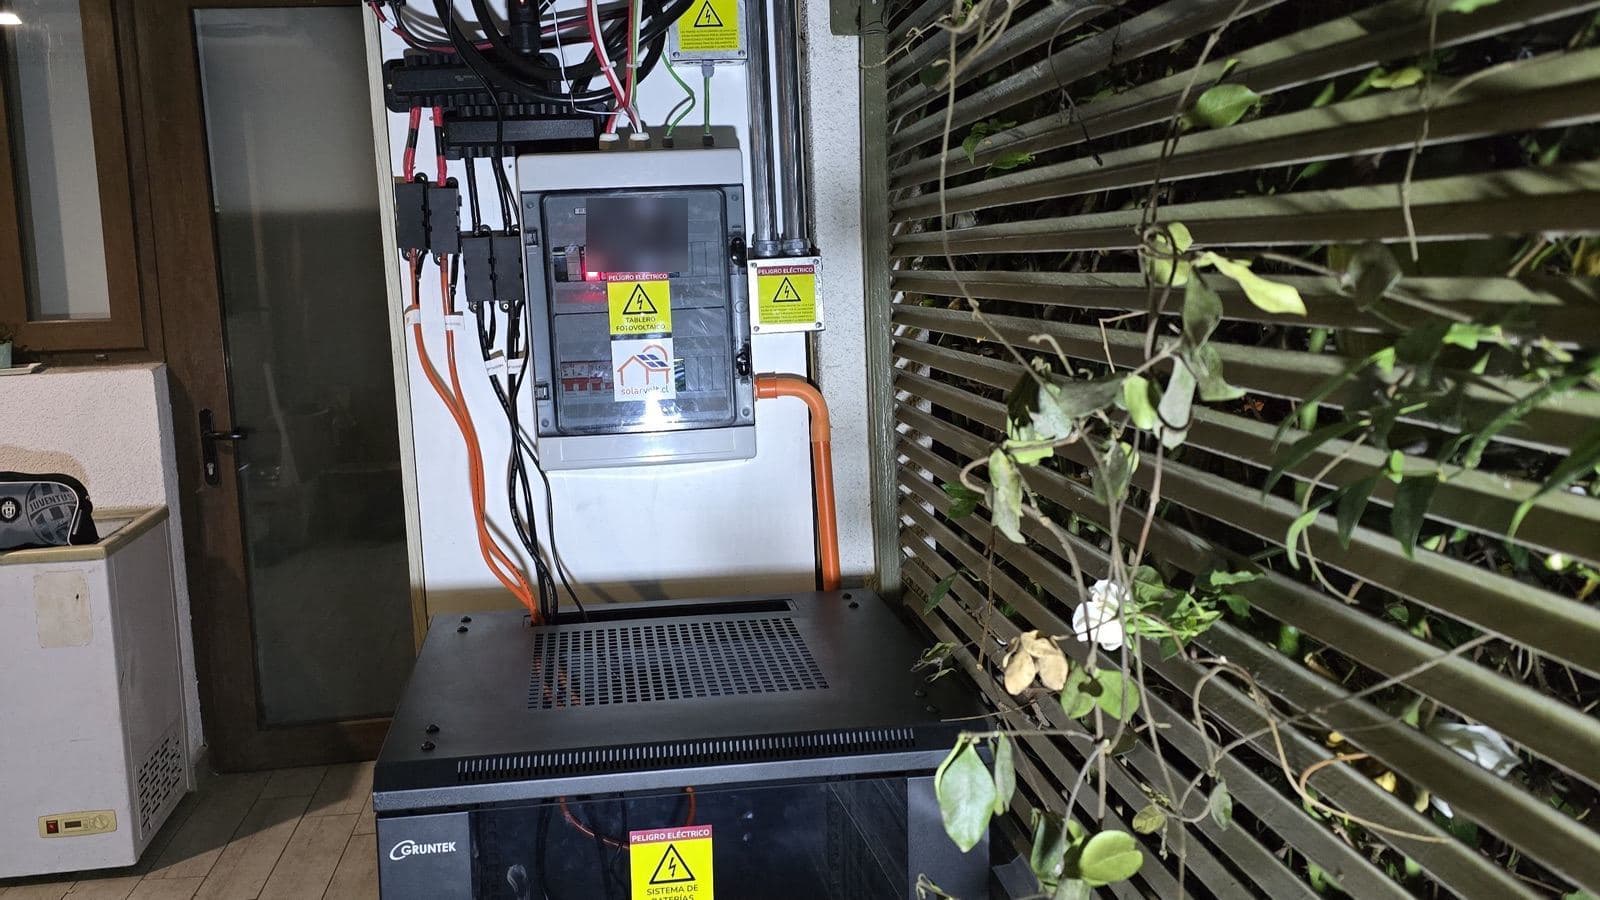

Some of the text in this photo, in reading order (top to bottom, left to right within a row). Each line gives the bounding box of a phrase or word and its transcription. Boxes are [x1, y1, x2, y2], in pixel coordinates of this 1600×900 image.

[631, 828, 710, 842] PELIGRO ELÉCTRICO
[400, 841, 457, 856] GRUNTEK
[647, 884, 698, 896] SISTEMA DE
